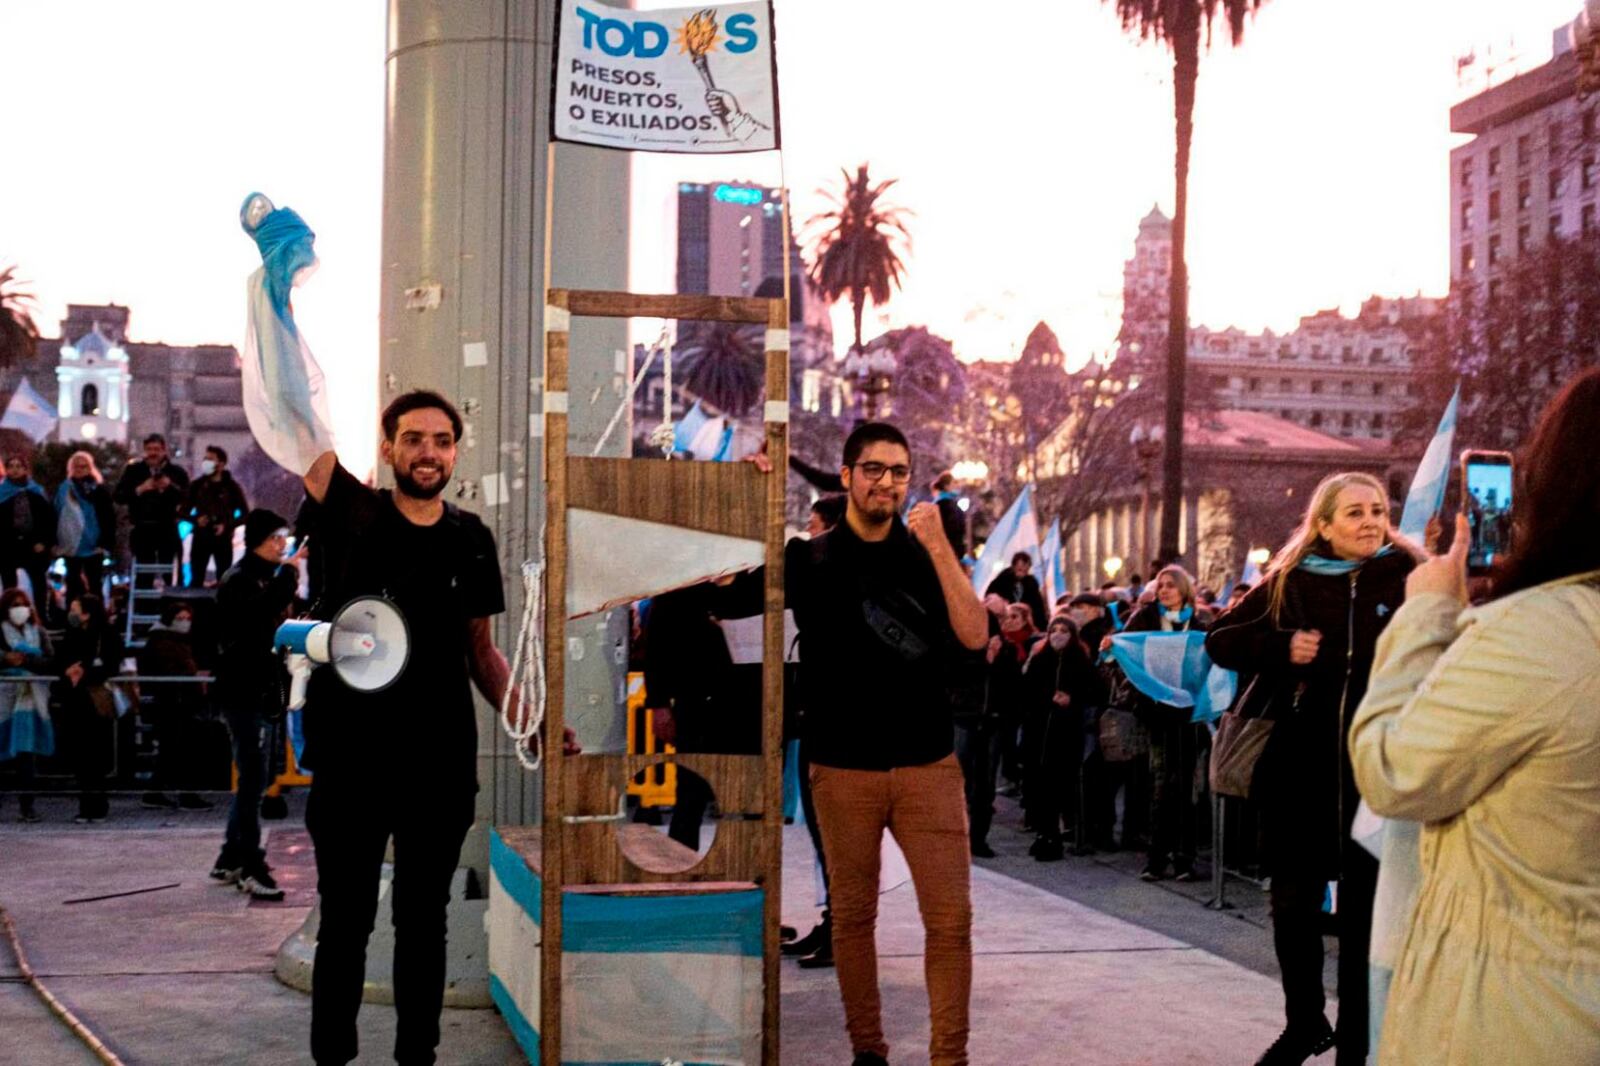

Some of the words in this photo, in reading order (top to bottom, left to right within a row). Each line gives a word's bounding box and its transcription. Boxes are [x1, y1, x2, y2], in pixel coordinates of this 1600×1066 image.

[571, 58, 662, 89] PRESOS,
[570, 81, 684, 111] MUERTOS,
[569, 104, 585, 120] O
[591, 109, 718, 131] EXILIADOS.
